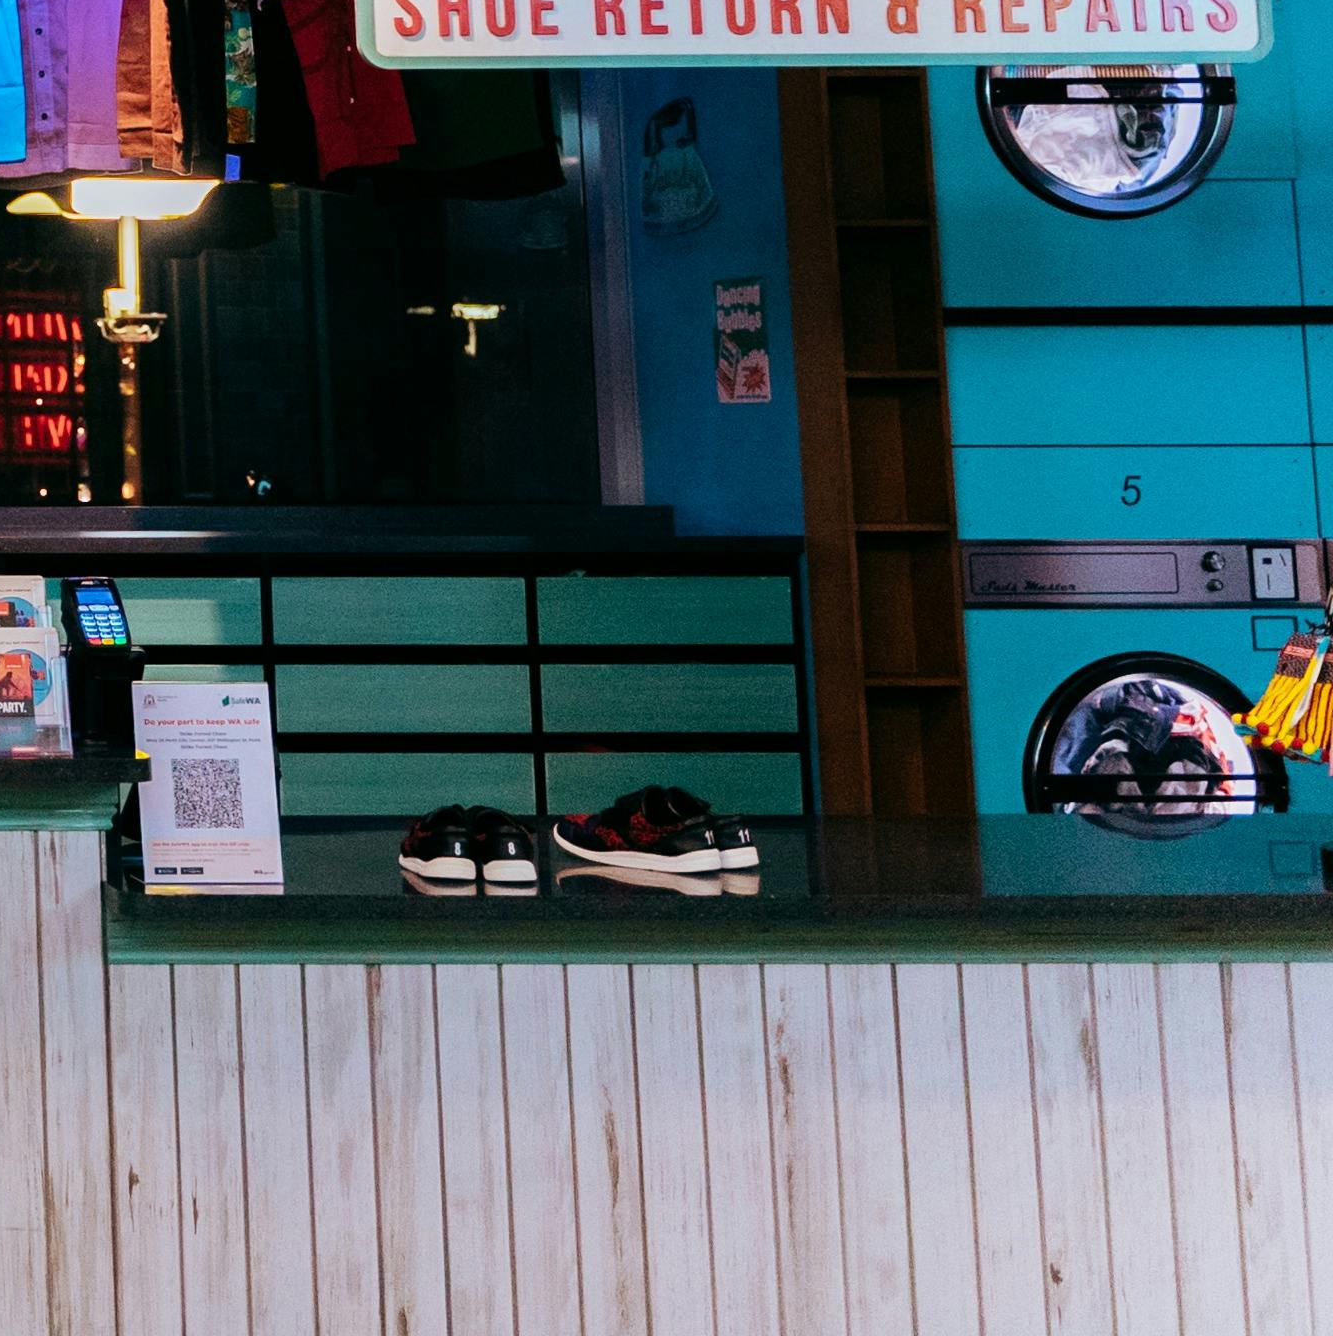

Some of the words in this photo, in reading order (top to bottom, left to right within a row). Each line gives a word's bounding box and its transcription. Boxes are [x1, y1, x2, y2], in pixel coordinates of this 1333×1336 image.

[1120, 475, 1142, 506] 5
[981, 581, 1018, 592] Suds
[1023, 580, 1077, 592] Master
[738, 828, 751, 844] 11
[454, 841, 462, 855] 8
[508, 841, 516, 855] 8
